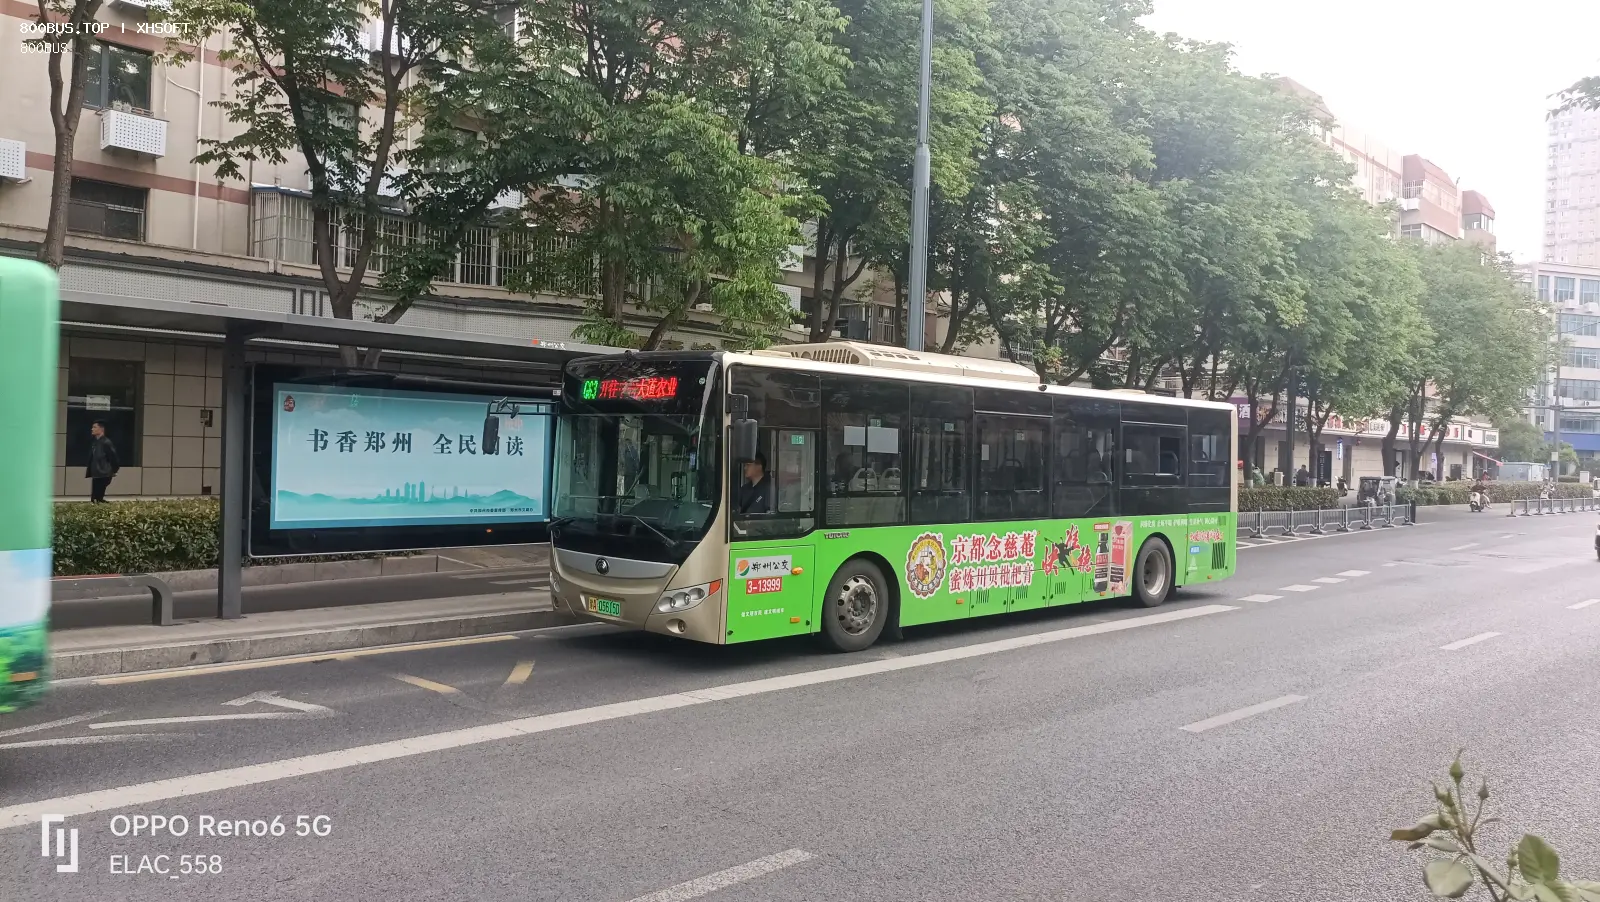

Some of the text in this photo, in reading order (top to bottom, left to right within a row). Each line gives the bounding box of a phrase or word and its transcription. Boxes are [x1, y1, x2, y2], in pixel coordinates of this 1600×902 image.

[1239, 404, 1251, 419] 酒
[306, 428, 412, 453] 书香郑州
[751, 559, 790, 572] 郑州公交
[950, 562, 1033, 591] 蜜炼川贝枇杷膏
[747, 578, 781, 593] 3-13999
